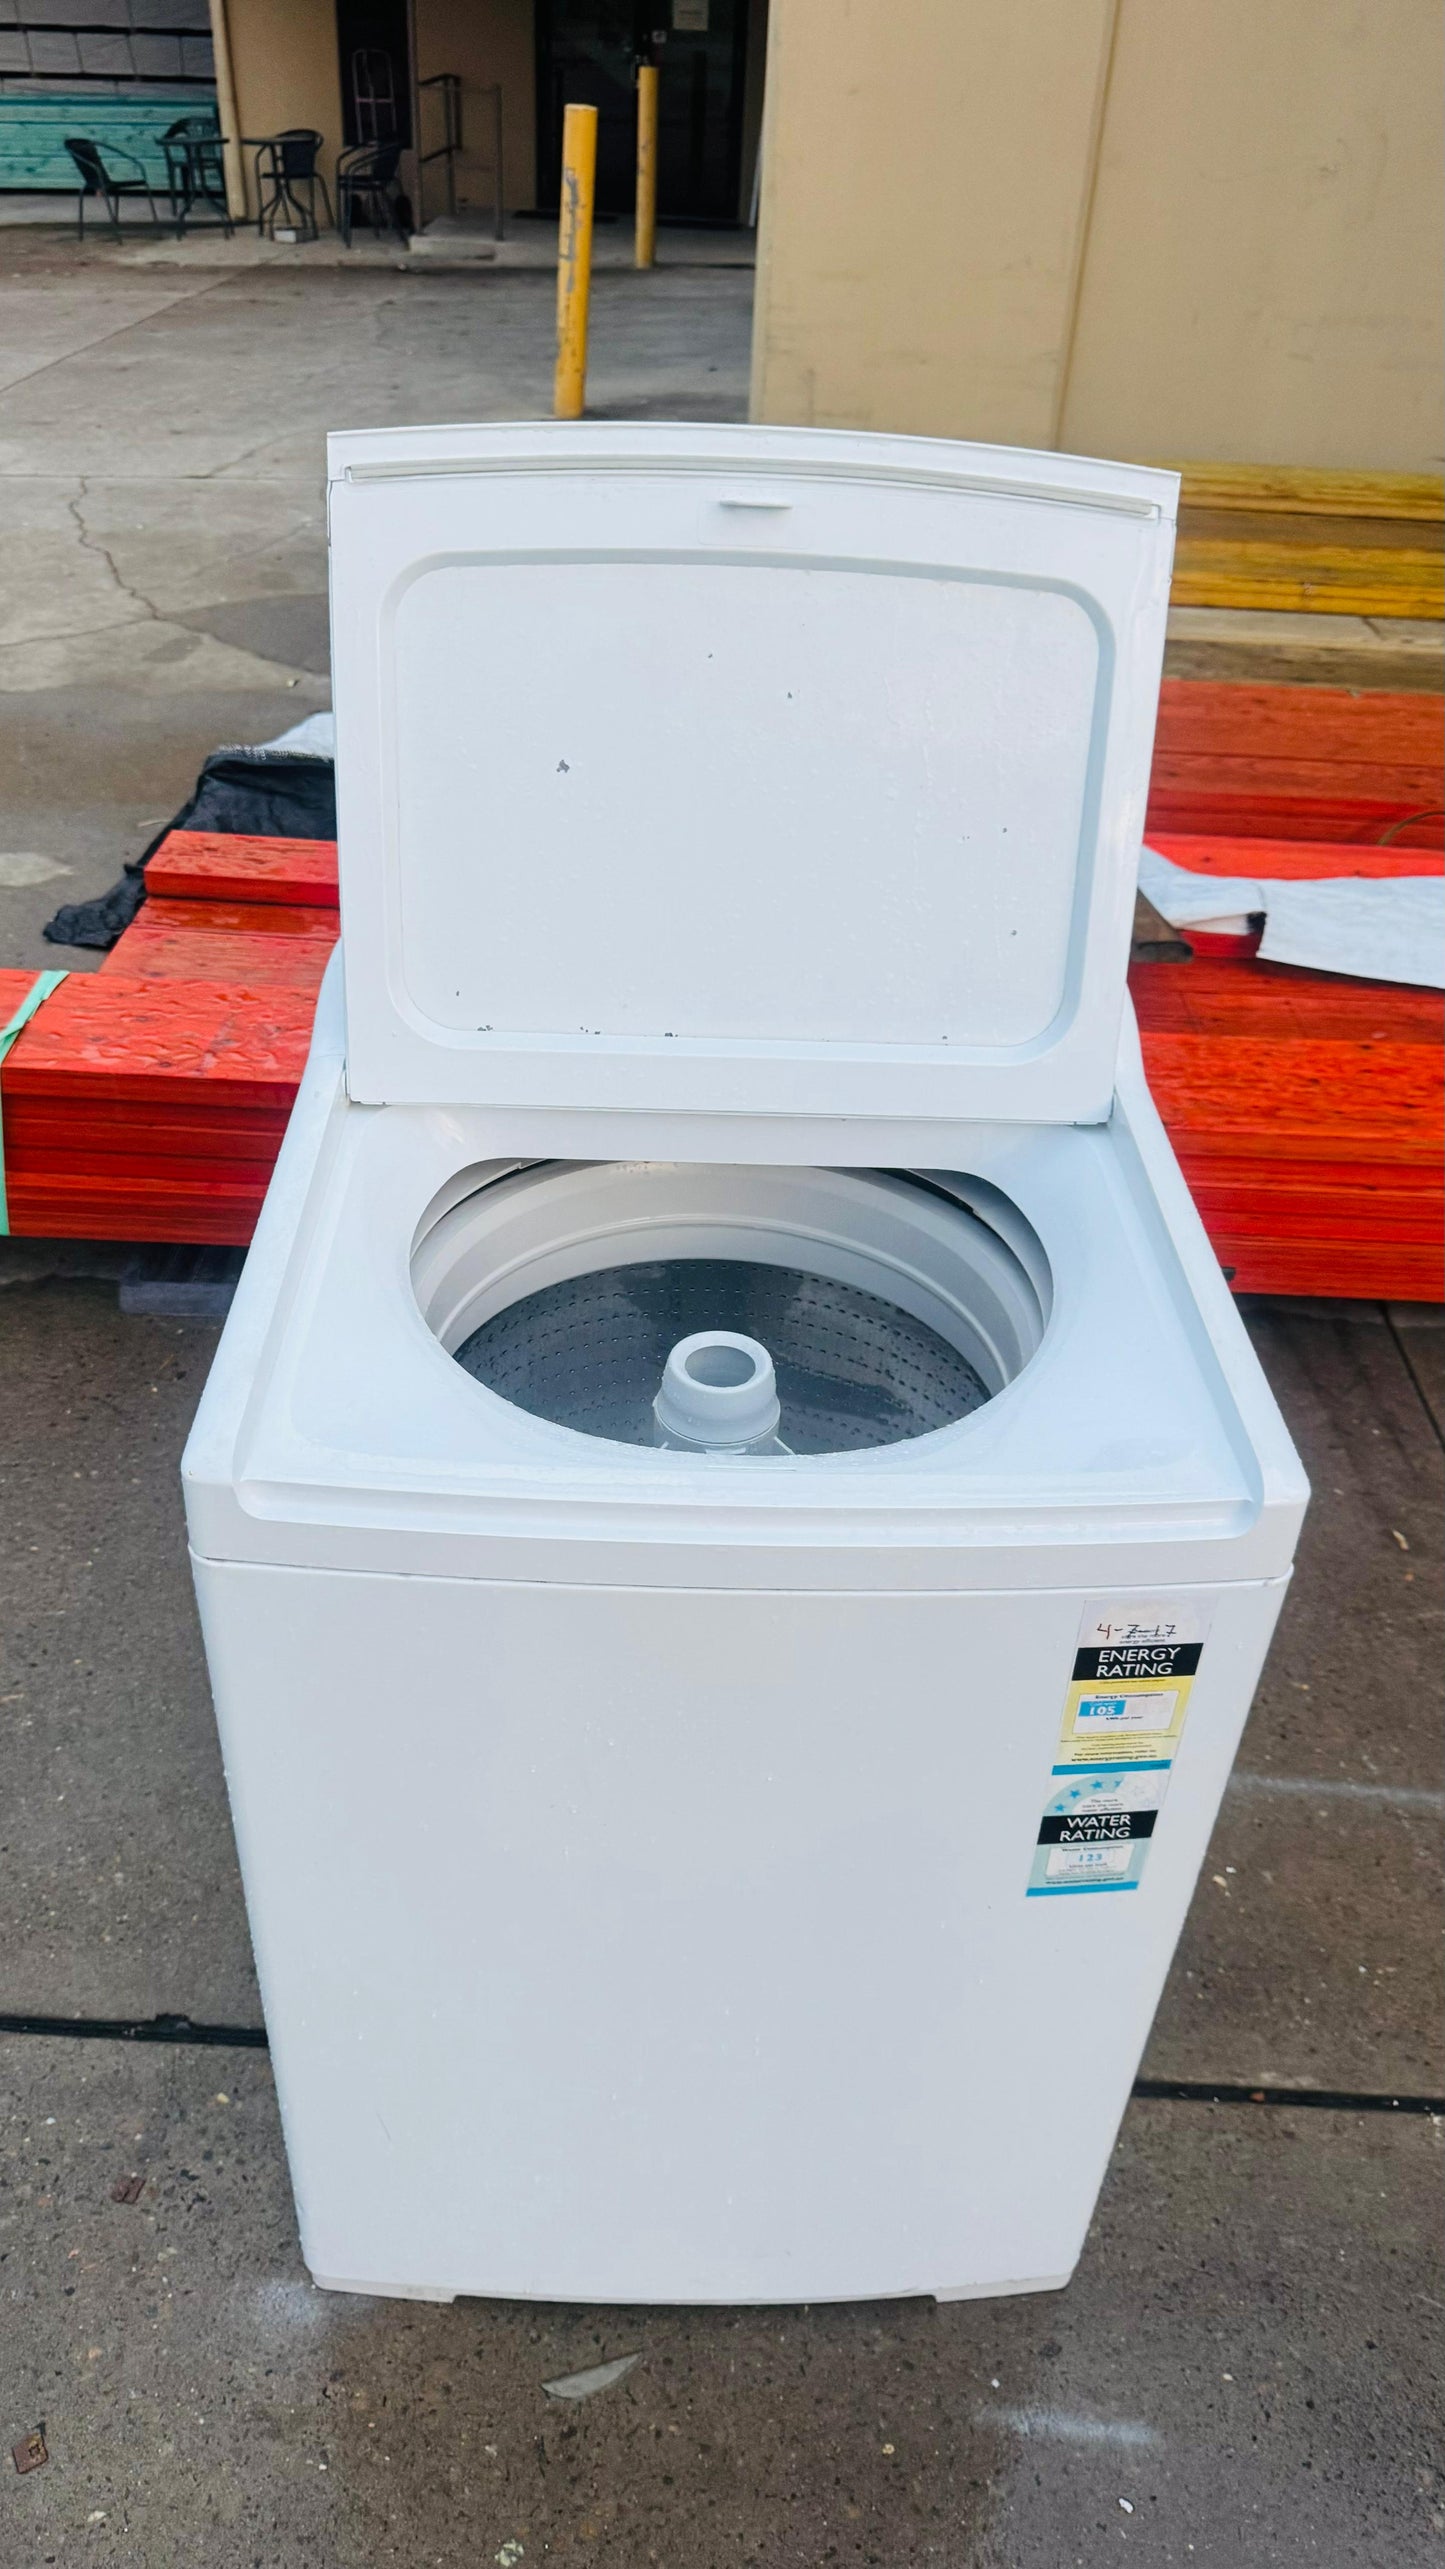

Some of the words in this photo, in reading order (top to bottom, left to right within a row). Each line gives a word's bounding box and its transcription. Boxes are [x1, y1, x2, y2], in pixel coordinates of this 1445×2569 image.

[1098, 1647, 1181, 1663] ENERGY
[1096, 1662, 1174, 1678] RATING
[1089, 1705, 1116, 1715] 105
[1066, 1814, 1131, 1828] WATER
[1059, 1827, 1131, 1842] RATING
